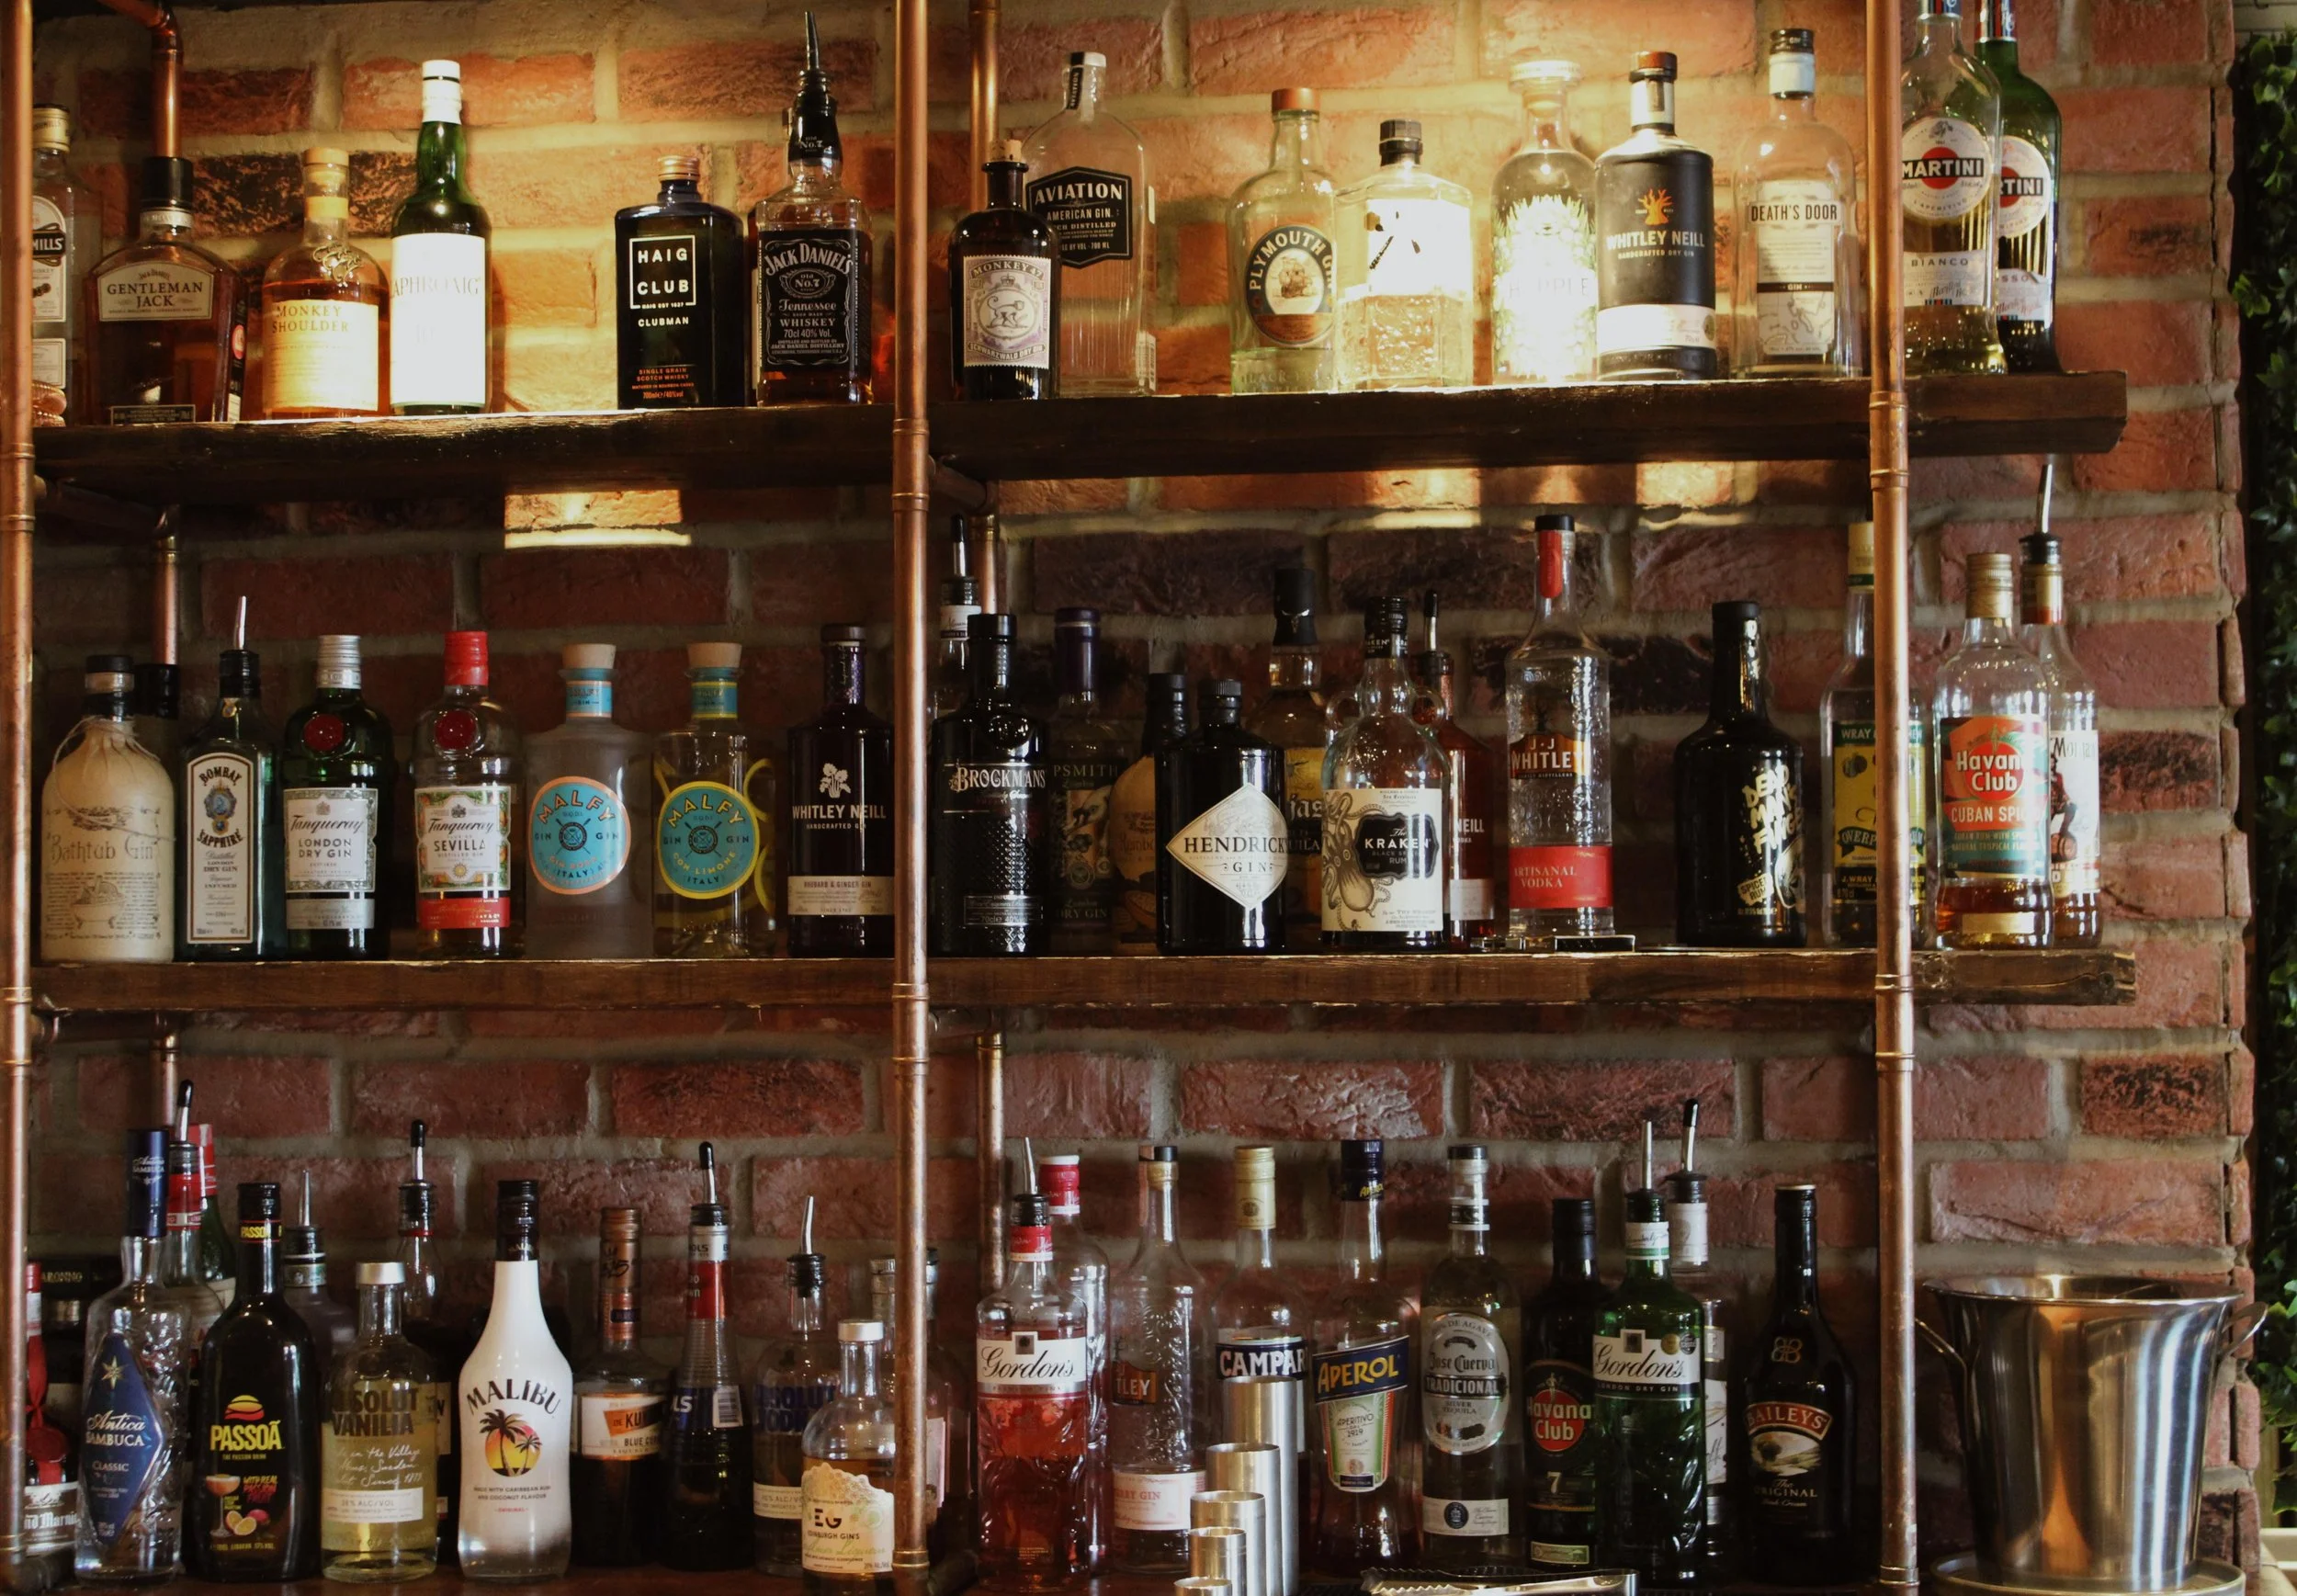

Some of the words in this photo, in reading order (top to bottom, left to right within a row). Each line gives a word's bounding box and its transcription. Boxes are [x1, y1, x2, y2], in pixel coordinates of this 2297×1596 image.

[1902, 160, 1984, 179] MARTINI
[1035, 182, 1123, 206] AVIATION
[1047, 209, 1092, 221] AMERICAN
[1094, 208, 1111, 219] GIN
[1751, 204, 1800, 221] DEATH'S
[1805, 204, 1837, 220] DOOR
[1070, 221, 1117, 230] DISTILLED
[1607, 231, 1667, 250] WHITLEY
[1671, 231, 1705, 248] NEILL
[638, 248, 687, 264] HAIG
[764, 248, 798, 276] JACK
[799, 243, 854, 275] DANIEL'S
[1249, 231, 1327, 291] PLYMOUTH
[1911, 257, 1969, 267] BIANCO
[973, 261, 1030, 275] MONKEY
[107, 282, 203, 295] GENTLEMAN
[637, 278, 689, 296] CLUB
[1509, 277, 1590, 299] HPPLE
[136, 295, 175, 308] JACK
[778, 299, 837, 311] Tennessee
[277, 306, 342, 317] MONKEY
[272, 321, 348, 334] SHOULDER
[638, 317, 689, 327] CLUBMAN
[779, 319, 836, 328] WHISKEY
[800, 329, 818, 338] 40%
[1841, 729, 1872, 739] WRAY
[1956, 750, 2021, 772] Havan
[198, 766, 243, 783] BOMBAY
[956, 766, 1046, 792] BROCKMANS
[1972, 772, 2018, 791] Club
[537, 789, 616, 823] MALFY
[667, 794, 745, 828] MALFY
[792, 804, 845, 819] WHITLEY
[850, 804, 887, 819] NEILL
[1952, 806, 1993, 823] CUBAN
[289, 814, 365, 834] Tanqueray
[427, 818, 494, 834] Tanqueray
[196, 829, 243, 848] SAPPHIRE
[534, 832, 551, 841] GIN
[595, 832, 619, 841] GIN
[726, 835, 750, 843] GIN
[1389, 828, 1409, 837] The
[48, 833, 116, 864] Bathtub
[124, 833, 153, 860] Gin
[299, 838, 352, 847] LONDON
[434, 840, 486, 852] SEVILLA
[1288, 838, 1320, 851] UILA
[1364, 838, 1429, 849] KRAKEN
[299, 849, 322, 858] DRY
[327, 849, 352, 858] GIN
[695, 851, 736, 875] LIMONE
[1232, 861, 1268, 873] GIN
[557, 868, 588, 878] ITALY
[1514, 866, 1577, 877] ARTISANAL
[686, 876, 719, 885] ITALY
[1521, 877, 1563, 888] VODKA
[1448, 1319, 1460, 1329] DE
[1461, 1319, 1492, 1337] AGAVE
[981, 1345, 1075, 1379] Gordon's
[1454, 1354, 1496, 1373] Cuervo
[1594, 1341, 1684, 1378] Gordon's
[1318, 1354, 1399, 1394] APEROL
[1426, 1377, 1499, 1396] TRADICIONAL
[1597, 1383, 1631, 1391] LONDON
[466, 1378, 561, 1416] MALIBU
[1443, 1407, 1477, 1415] TEQUILA
[1526, 1397, 1592, 1421] Havana
[86, 1409, 147, 1432] Antica
[1337, 1413, 1375, 1427] APERITIVO
[1748, 1406, 1823, 1430] BAILEYS
[209, 1420, 283, 1452] PASSOÃ
[1347, 1428, 1363, 1438] 1919
[1534, 1420, 1575, 1441] Club
[85, 1433, 145, 1447] SAMBUCA
[624, 1436, 643, 1446] BLUE
[92, 1460, 129, 1471] CLASSIC
[1547, 1471, 1561, 1494] 7
[1773, 1478, 1793, 1488] The
[1139, 1491, 1161, 1500] GIN
